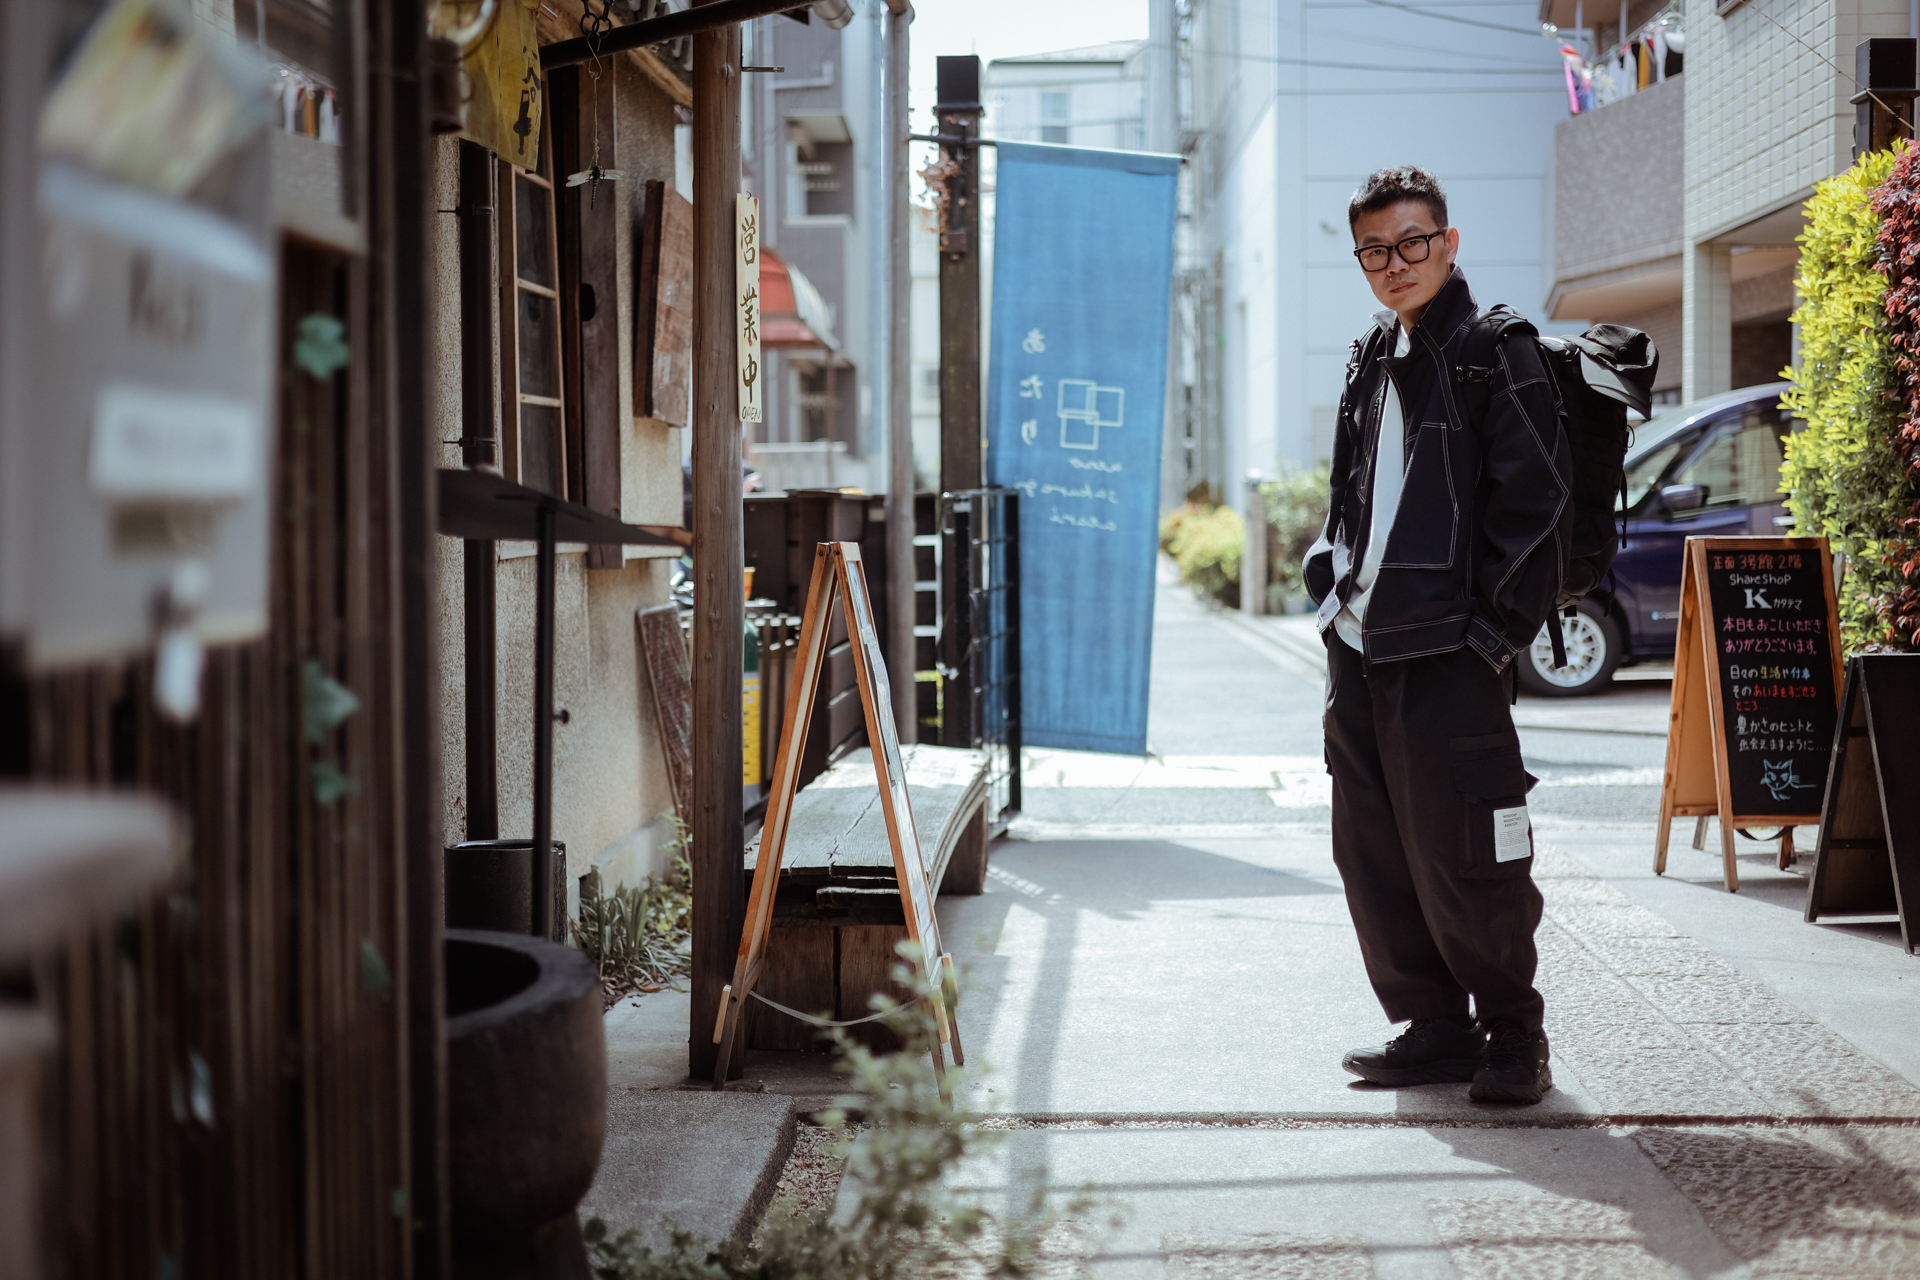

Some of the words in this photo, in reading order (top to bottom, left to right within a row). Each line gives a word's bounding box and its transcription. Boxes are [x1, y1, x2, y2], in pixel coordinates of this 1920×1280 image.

[740, 213, 758, 404] 営業中
[741, 405, 761, 420] OPEN
[1743, 588, 1772, 609] K
[1722, 615, 1822, 634] 本日もおこしいただき
[1724, 638, 1817, 655] ありがとうございます。
